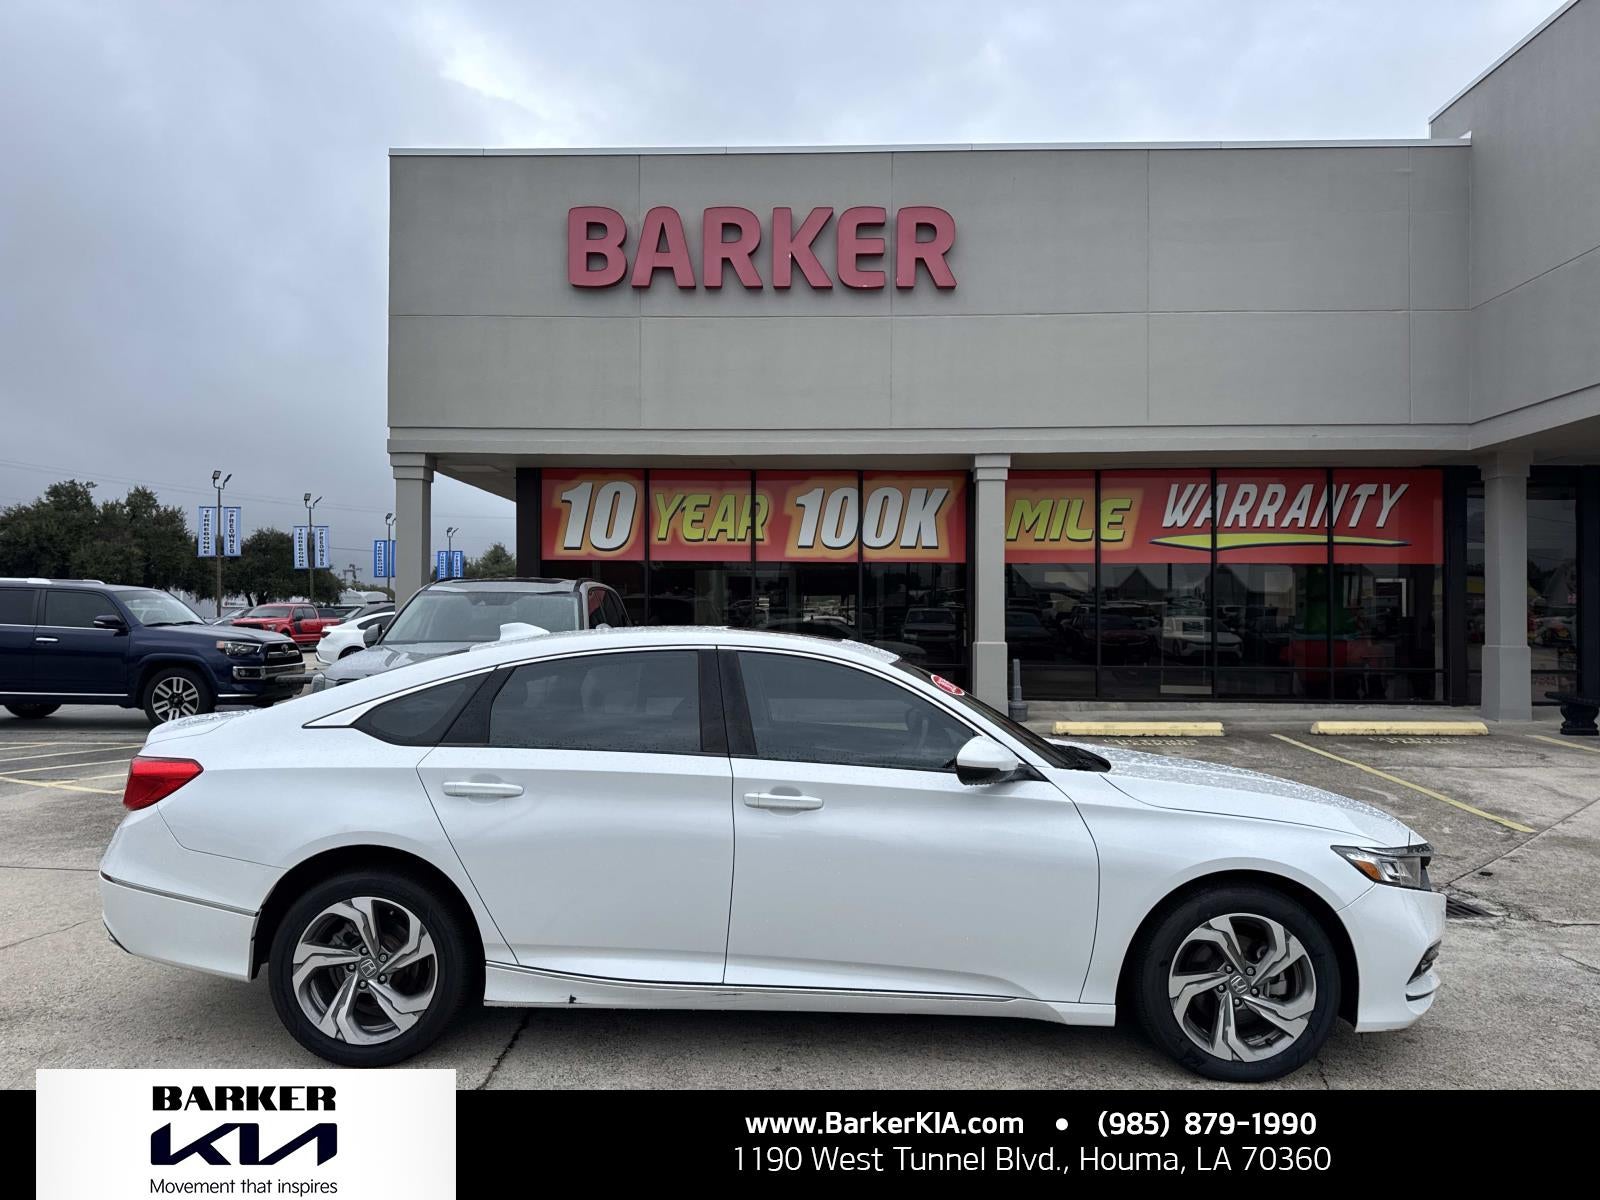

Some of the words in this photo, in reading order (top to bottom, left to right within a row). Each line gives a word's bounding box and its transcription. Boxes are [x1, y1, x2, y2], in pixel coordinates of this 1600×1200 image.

[568, 206, 957, 290] BARKER
[561, 481, 637, 551] 10
[656, 493, 769, 541] YEAR
[795, 487, 949, 549] 100K
[1006, 499, 1132, 541] MILE
[1162, 483, 1409, 528] WARRANTY
